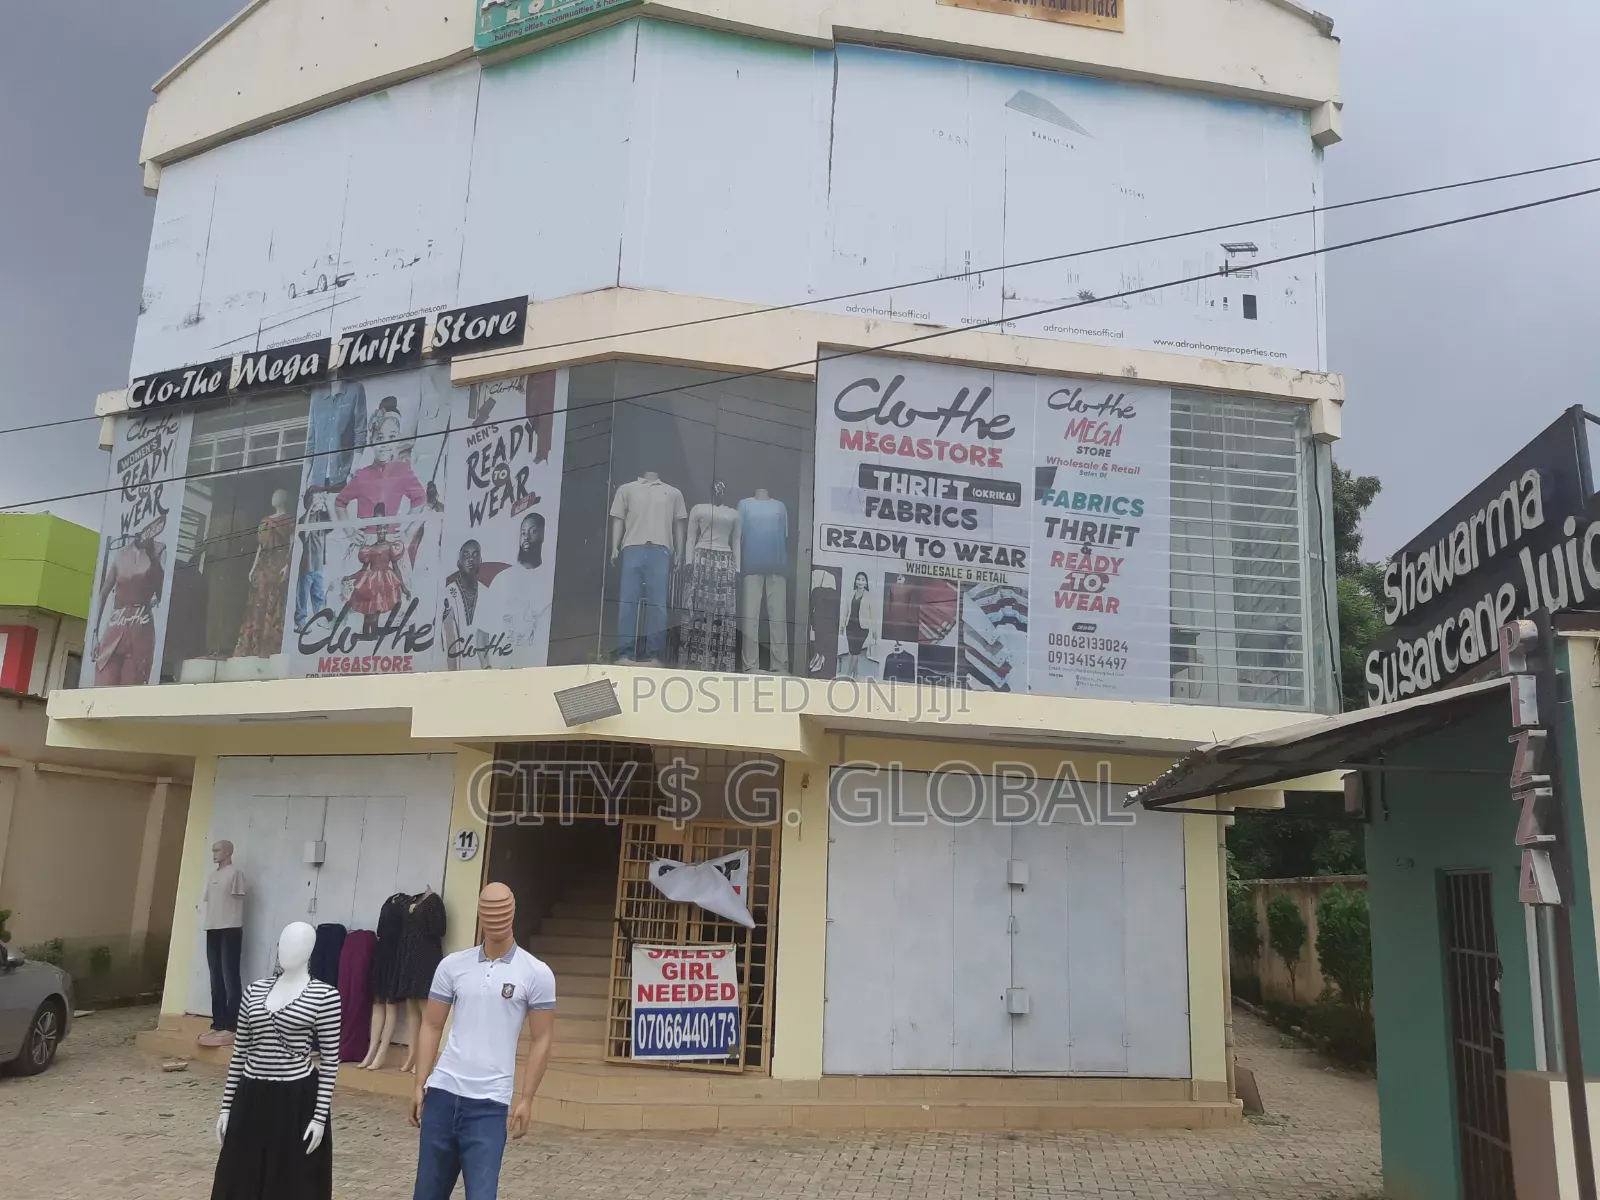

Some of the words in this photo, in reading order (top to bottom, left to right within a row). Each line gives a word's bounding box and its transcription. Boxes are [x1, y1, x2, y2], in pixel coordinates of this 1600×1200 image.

[547, 5, 593, 24] communities
[845, 304, 931, 320] adronhomesofficial
[1043, 324, 1124, 339] adronhomesofficial
[126, 366, 222, 409] Clo-The
[235, 353, 320, 385] Mega
[337, 323, 416, 367] Thrift
[432, 310, 517, 347] Store
[1153, 338, 1287, 359] www.adronhomesproperties.com
[466, 423, 500, 448] MEN'S
[1064, 417, 1123, 447] MEGA
[121, 440, 158, 469] WOMEN'S
[466, 420, 540, 490] READY
[839, 428, 1004, 468] MEGASTORE
[1076, 446, 1112, 458] STORE
[121, 439, 174, 503] READY
[493, 469, 508, 480] TO
[1046, 456, 1099, 471] Wholesale
[1101, 462, 1108, 472] &
[1111, 464, 1140, 475] Retail
[1079, 469, 1098, 478] Sales
[469, 466, 541, 528] WEAR
[872, 470, 970, 501] THRIFT
[972, 487, 1016, 502] (OKRIKA)
[121, 482, 169, 533] WEAR
[865, 496, 978, 531] FABRICS
[1041, 488, 1145, 517] FABRICS
[1044, 516, 1140, 547] THRIFT
[826, 527, 908, 559] READY
[915, 537, 946, 559] TO
[953, 541, 1026, 568] WEAR
[1080, 541, 1093, 556] &
[1383, 468, 1545, 626] Shawarma
[906, 562, 962, 580] WHOLESALE
[966, 570, 973, 580] &
[976, 570, 1009, 584] RETAIL
[1050, 551, 1125, 574] READY
[1072, 572, 1102, 593] TO
[1054, 591, 1120, 614] WEAR
[1048, 633, 1128, 653] 08062133024
[1365, 582, 1516, 709] Sugarcane
[317, 655, 414, 673] MEGASTORE
[1048, 650, 1128, 671] 09134154497
[1500, 619, 1558, 905] PIZZA
[459, 831, 474, 848] 11
[647, 948, 727, 960] SALES
[661, 962, 719, 981] GIRL
[637, 982, 736, 1003] NEEDED
[637, 1012, 737, 1050] 07066440173
